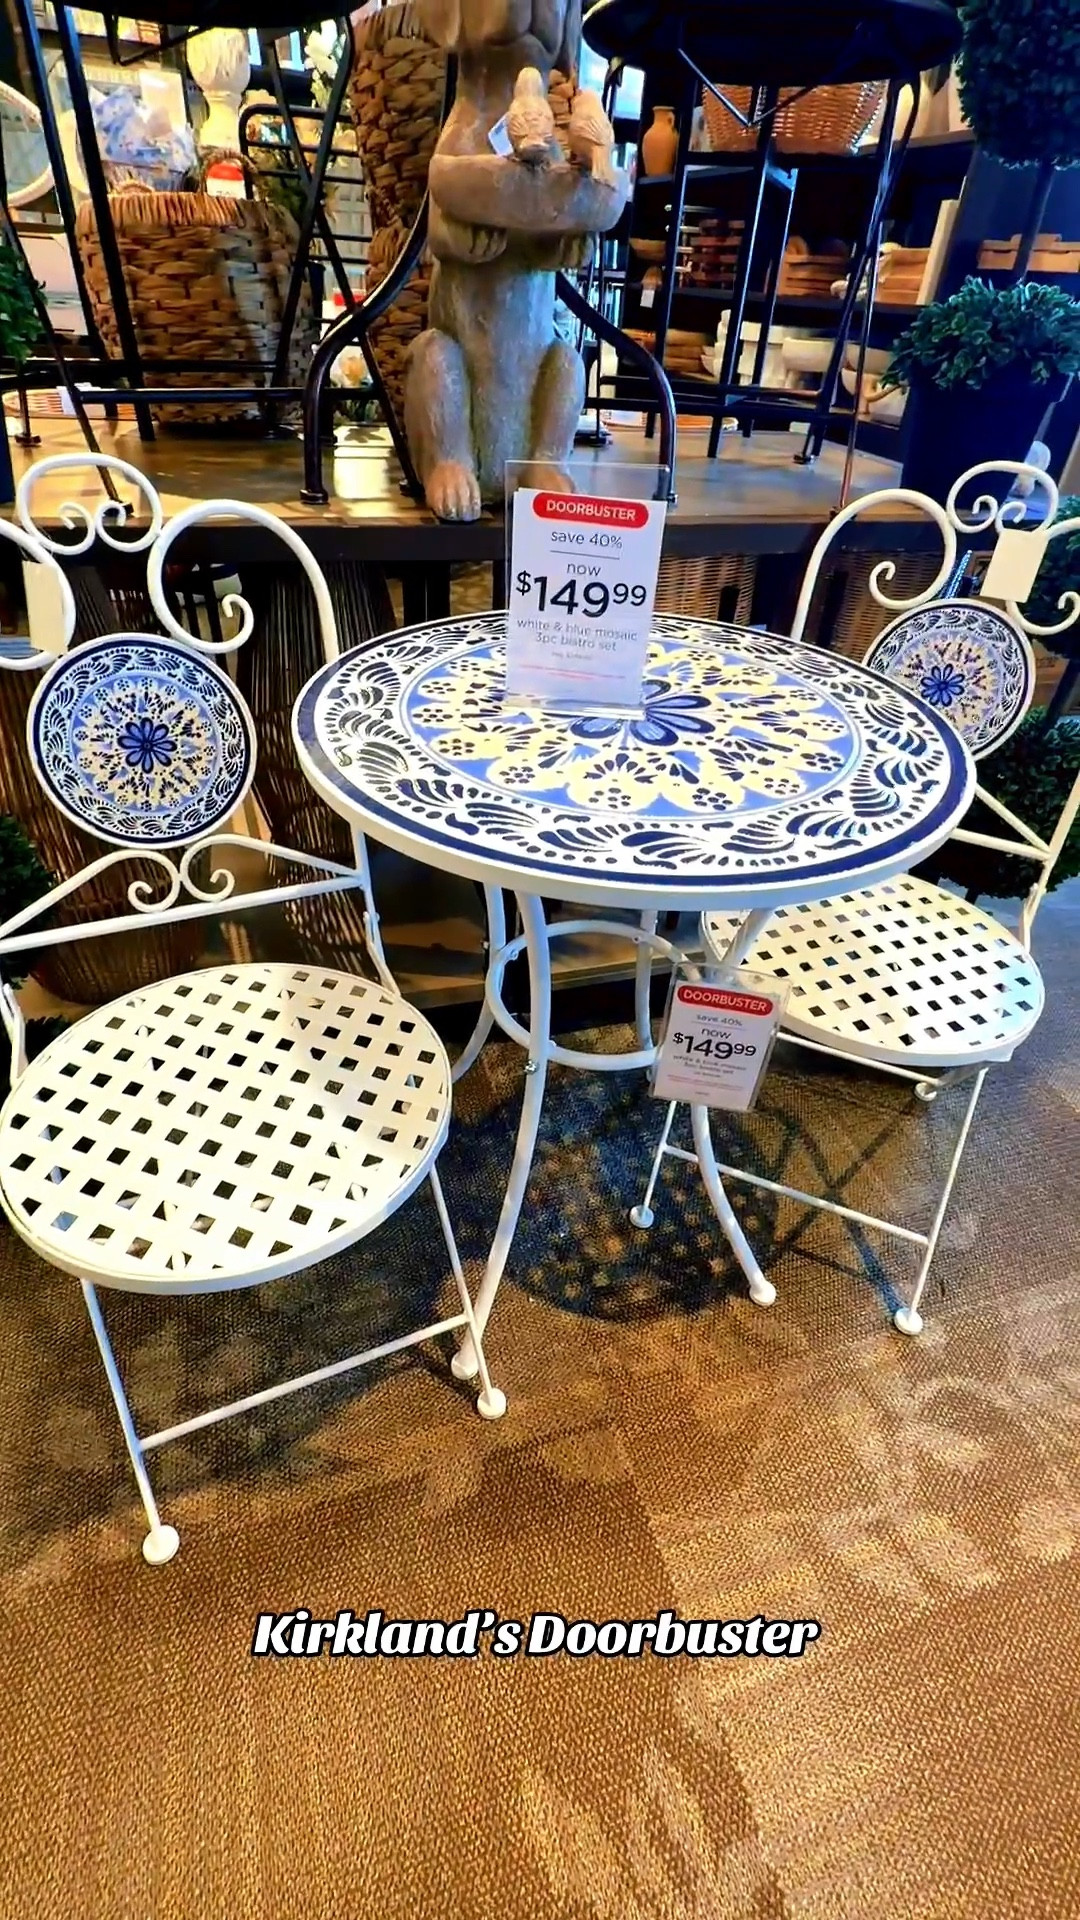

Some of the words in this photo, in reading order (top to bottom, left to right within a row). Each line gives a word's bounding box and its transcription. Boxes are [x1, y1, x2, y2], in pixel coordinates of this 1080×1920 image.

[546, 499, 636, 521] DOORBUSTER
[551, 531, 585, 545] save
[589, 532, 623, 549] 40%
[566, 562, 602, 577] now
[517, 618, 550, 632] white
[553, 621, 562, 632] &
[535, 631, 557, 645] 3pc
[683, 988, 768, 1012] DOORBUSTER
[696, 1013, 718, 1023] save
[721, 1015, 743, 1027] 40%
[701, 1028, 732, 1040] now
